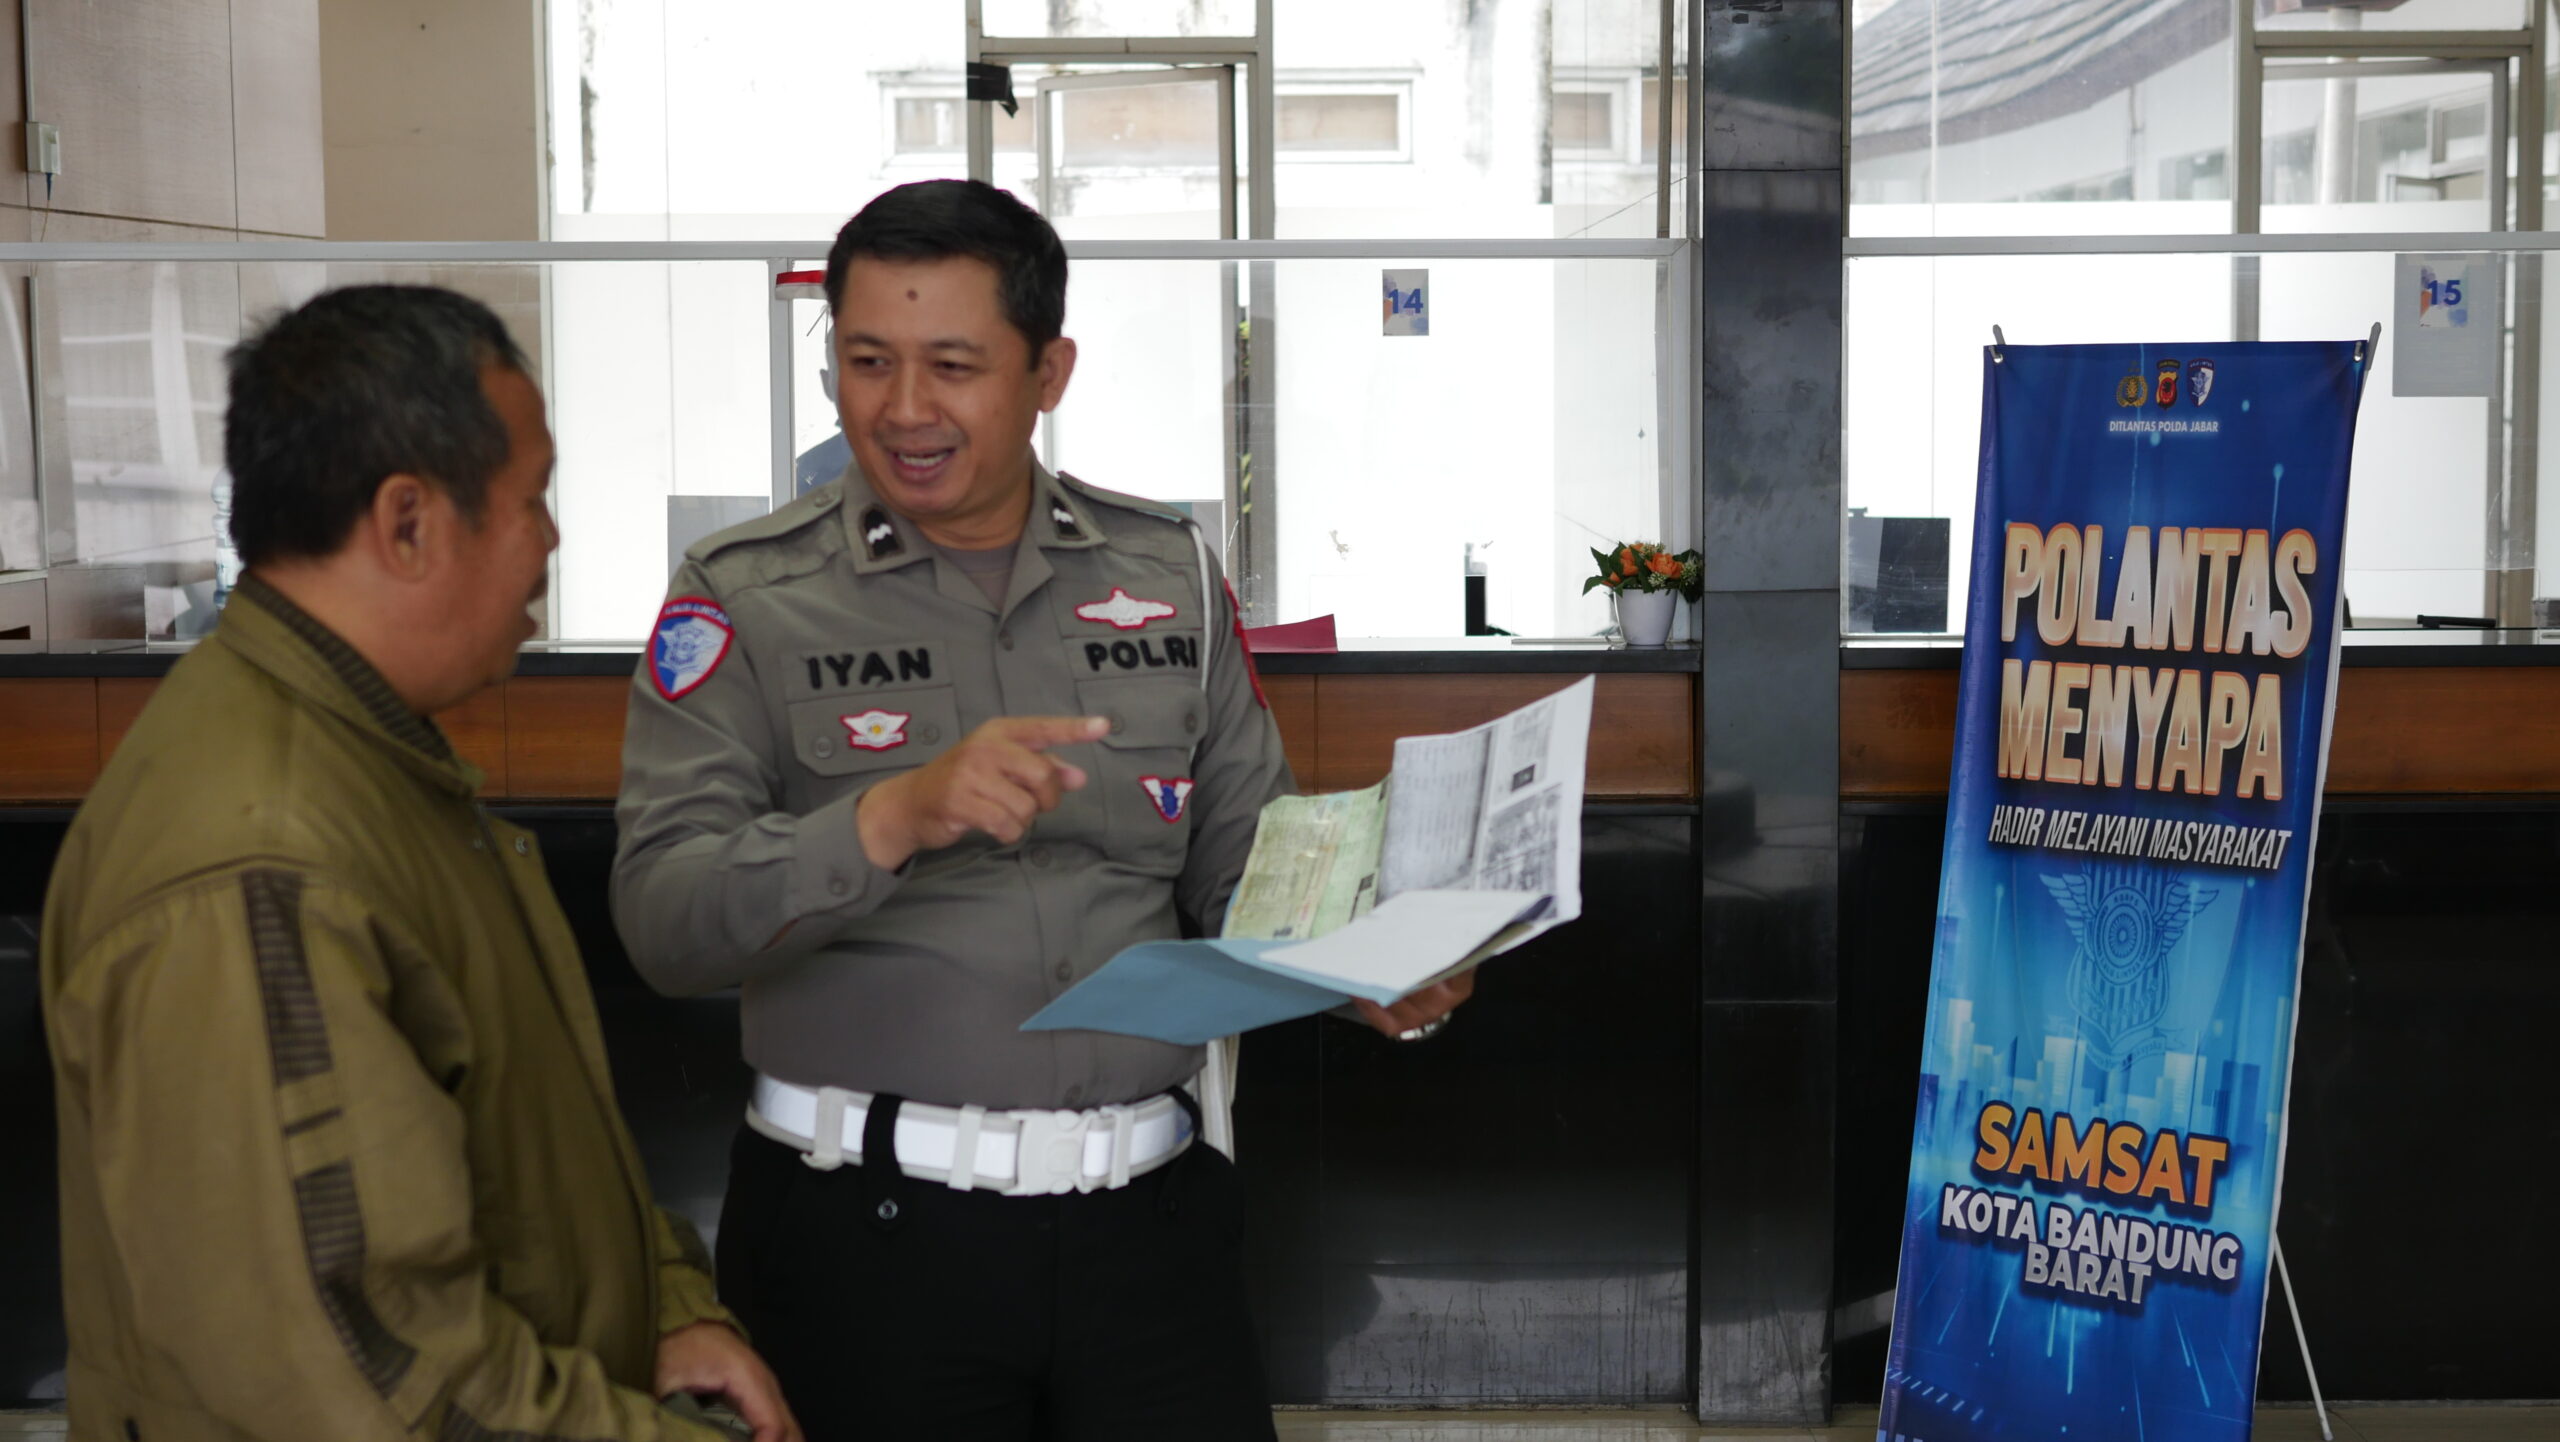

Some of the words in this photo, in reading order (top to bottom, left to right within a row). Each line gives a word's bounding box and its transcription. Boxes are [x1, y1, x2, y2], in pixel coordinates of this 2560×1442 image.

[1388, 288, 1424, 314] 14
[2427, 279, 2462, 306] 15
[2109, 420, 2156, 432] DITLANTAS
[2158, 421, 2187, 432] POLDA
[2190, 422, 2219, 432] JABAR
[2001, 522, 2317, 659] POLANTAS
[807, 647, 931, 690] IYAN
[1085, 636, 1198, 671] POLRI
[1997, 658, 2282, 801] MENYAPA
[1988, 804, 2045, 847] HADIR
[2043, 809, 2149, 857] MELAYANI
[2147, 818, 2293, 870] MASYARAKAT
[1975, 1104, 2229, 1208] SAMSAT
[1941, 1186, 2037, 1245] KOTA
[2047, 1206, 2240, 1281] BANDUNG
[2024, 1241, 2152, 1304] BARAT
